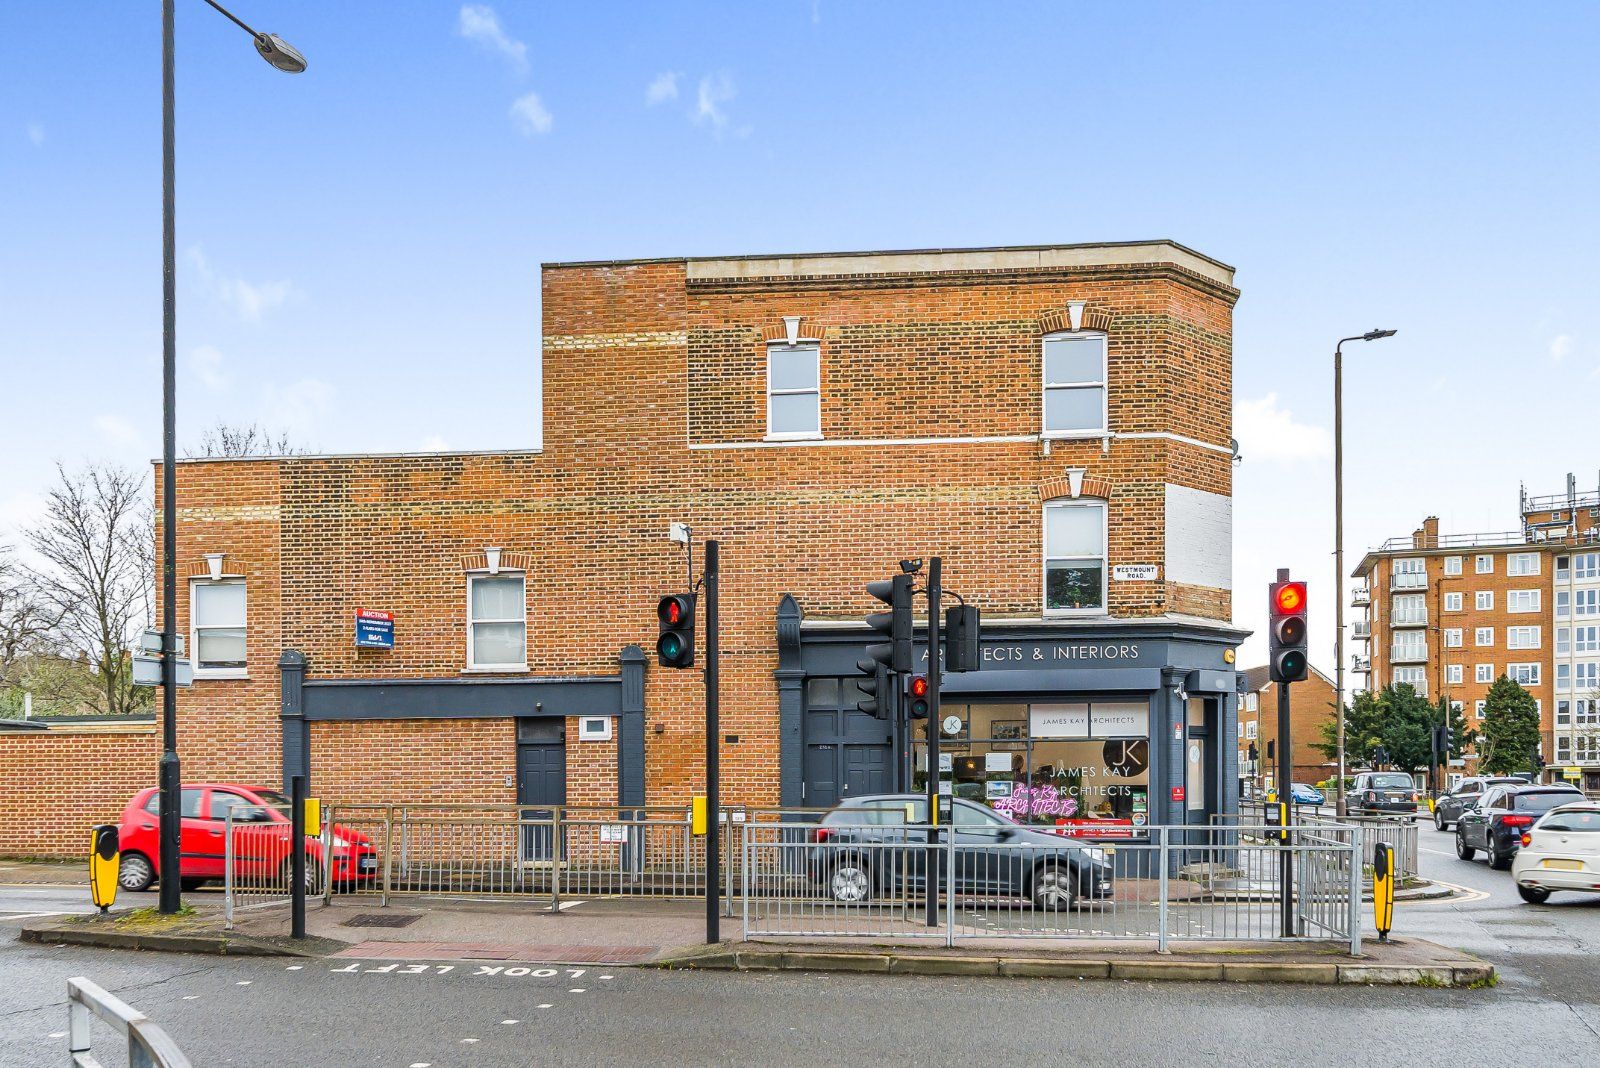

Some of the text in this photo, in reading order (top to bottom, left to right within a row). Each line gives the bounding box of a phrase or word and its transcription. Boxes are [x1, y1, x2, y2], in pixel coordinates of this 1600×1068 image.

[362, 611, 389, 619] AUCTION
[1032, 648, 1044, 660] &
[1053, 645, 1139, 660] INTERIORS
[1050, 766, 1131, 778] JAMES KAY
[1052, 785, 1132, 797] ARCHITECTS
[330, 963, 586, 979] LOOK LEFT
